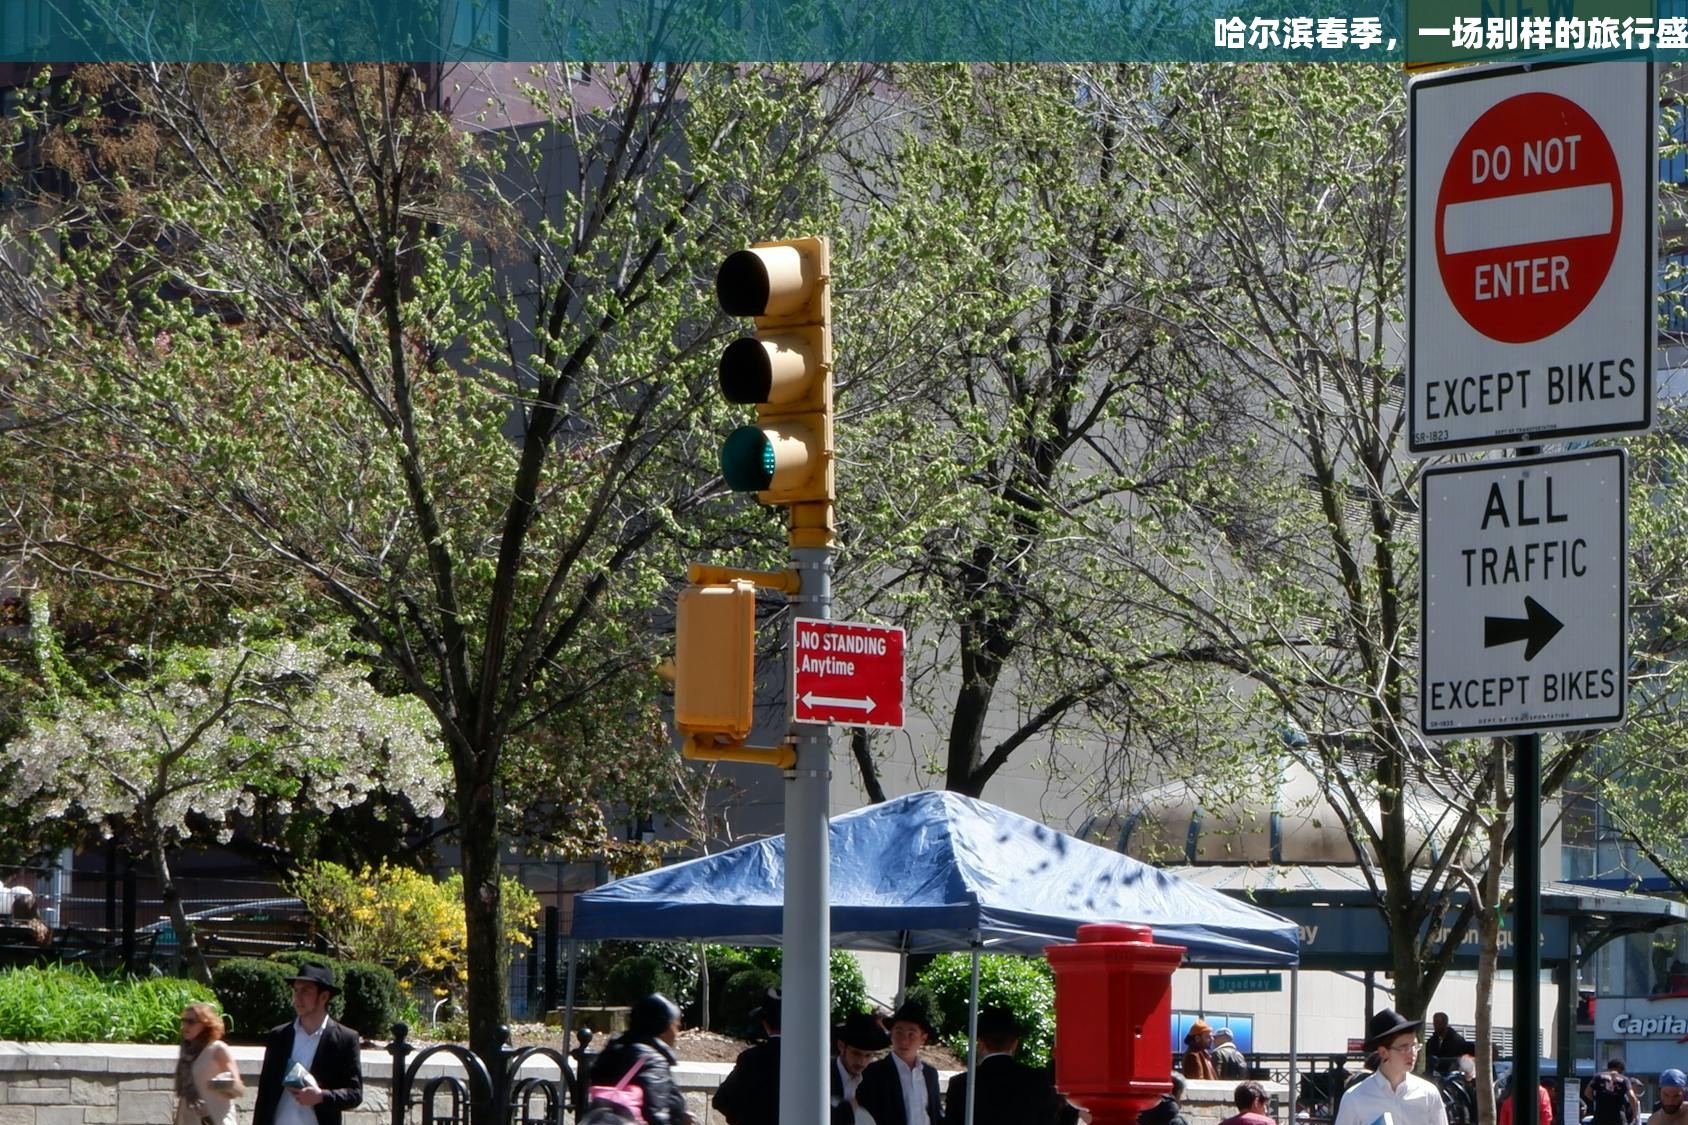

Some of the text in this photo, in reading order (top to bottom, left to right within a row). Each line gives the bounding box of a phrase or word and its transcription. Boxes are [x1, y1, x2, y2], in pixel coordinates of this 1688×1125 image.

[1472, 135, 1582, 185] DO NOT
[1475, 255, 1570, 301] ENTER
[1426, 358, 1636, 420] EXCEPT BIKES
[1481, 477, 1568, 530] ALL
[1462, 538, 1587, 587] TRAFFIC
[801, 631, 887, 656] NO STANDING
[802, 654, 855, 678] Anytime
[1431, 668, 1615, 711] EXCEPT BIKES
